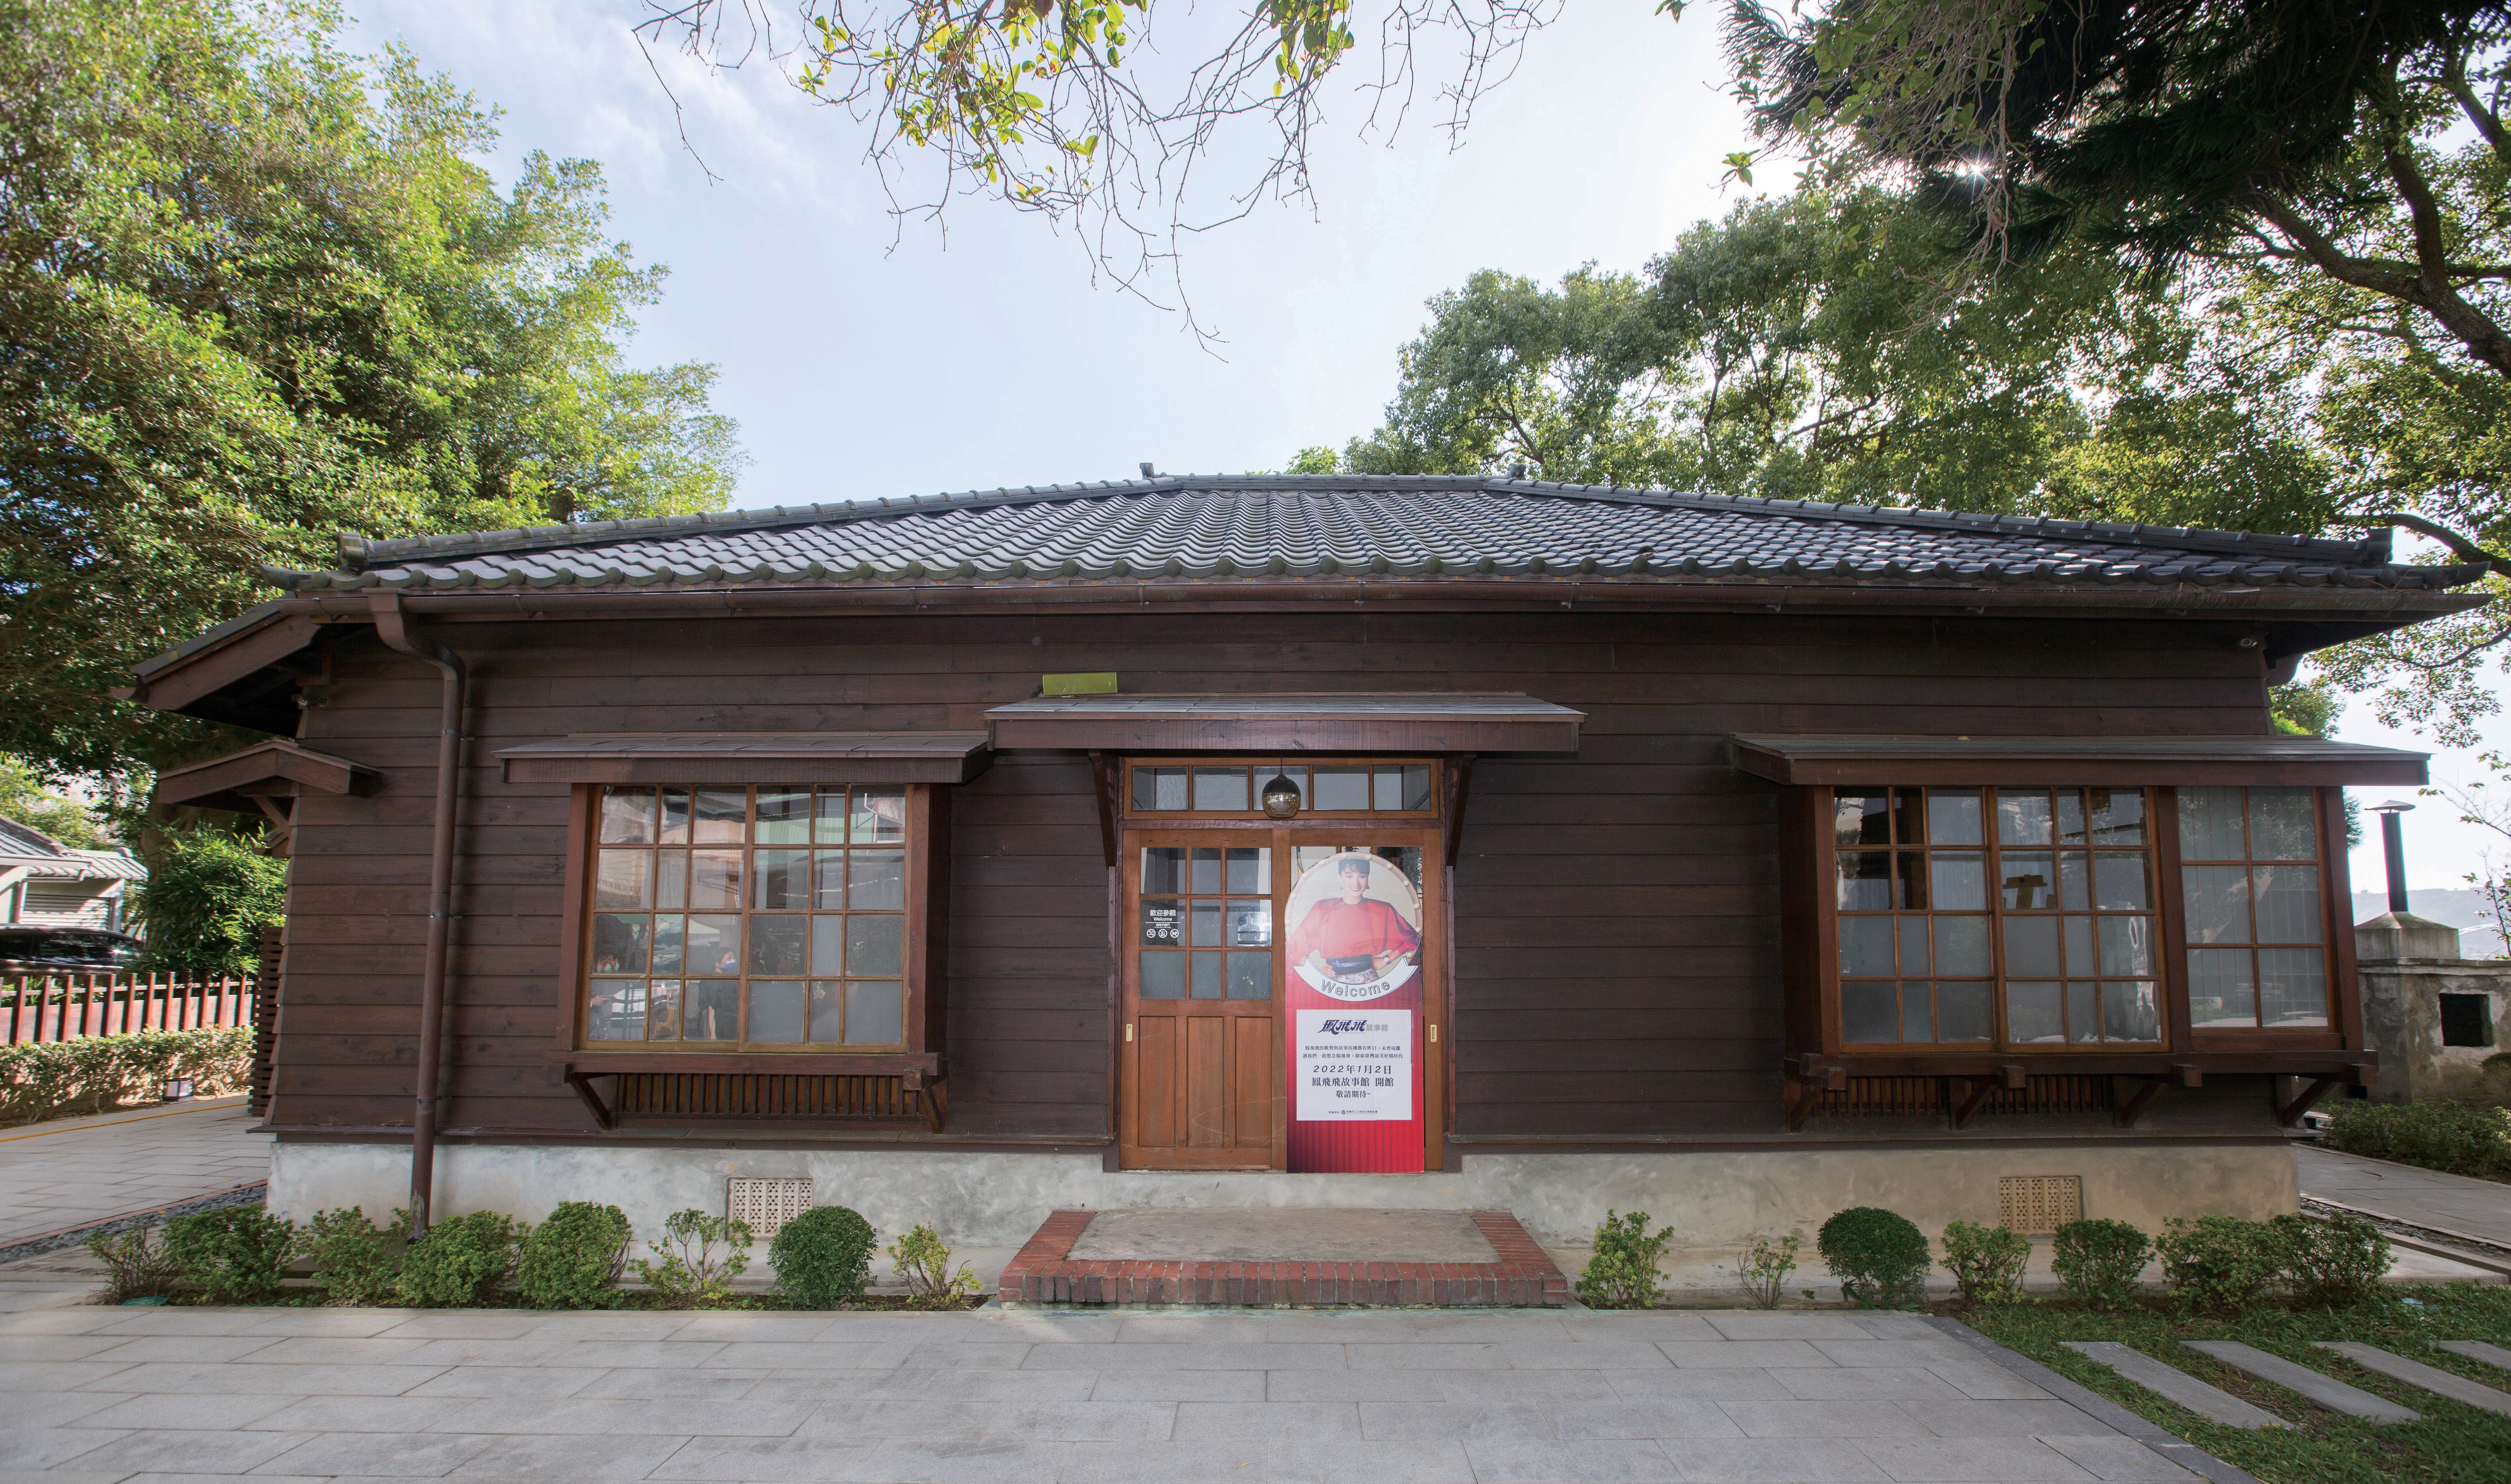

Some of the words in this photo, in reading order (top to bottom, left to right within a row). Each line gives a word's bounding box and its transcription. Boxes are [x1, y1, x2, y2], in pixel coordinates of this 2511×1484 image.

[1321, 979, 1390, 997] Welcome
[1313, 1065, 1391, 1075] 2022年1月2日
[1312, 1077, 1370, 1087] 鳳飛飛故事館
[1375, 1077, 1394, 1087] 開館
